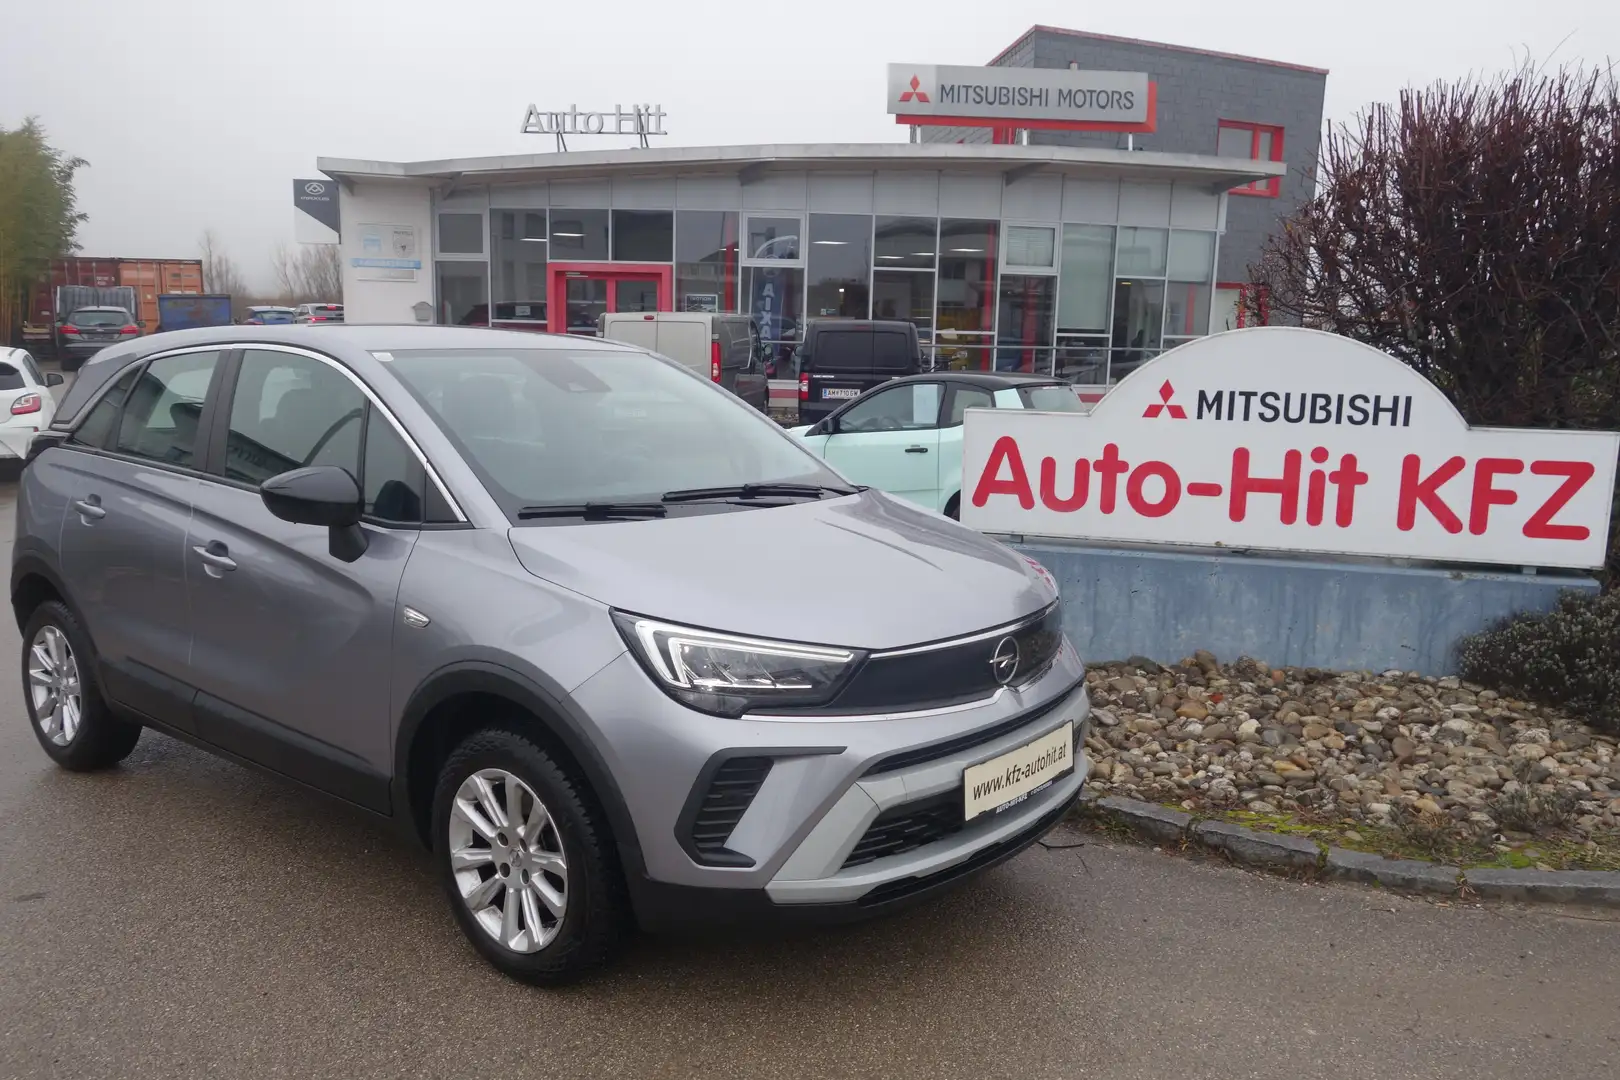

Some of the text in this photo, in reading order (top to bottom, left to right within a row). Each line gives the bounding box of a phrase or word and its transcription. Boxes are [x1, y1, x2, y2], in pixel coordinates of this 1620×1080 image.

[940, 84, 1135, 110] MITSUBISHI MOTORS
[520, 103, 667, 134] Auto Hit
[1197, 389, 1412, 427] MITSUBISHI
[972, 436, 1595, 541] Auto-Hit KFZ
[973, 742, 1067, 801] www.kfz-autohit.at
